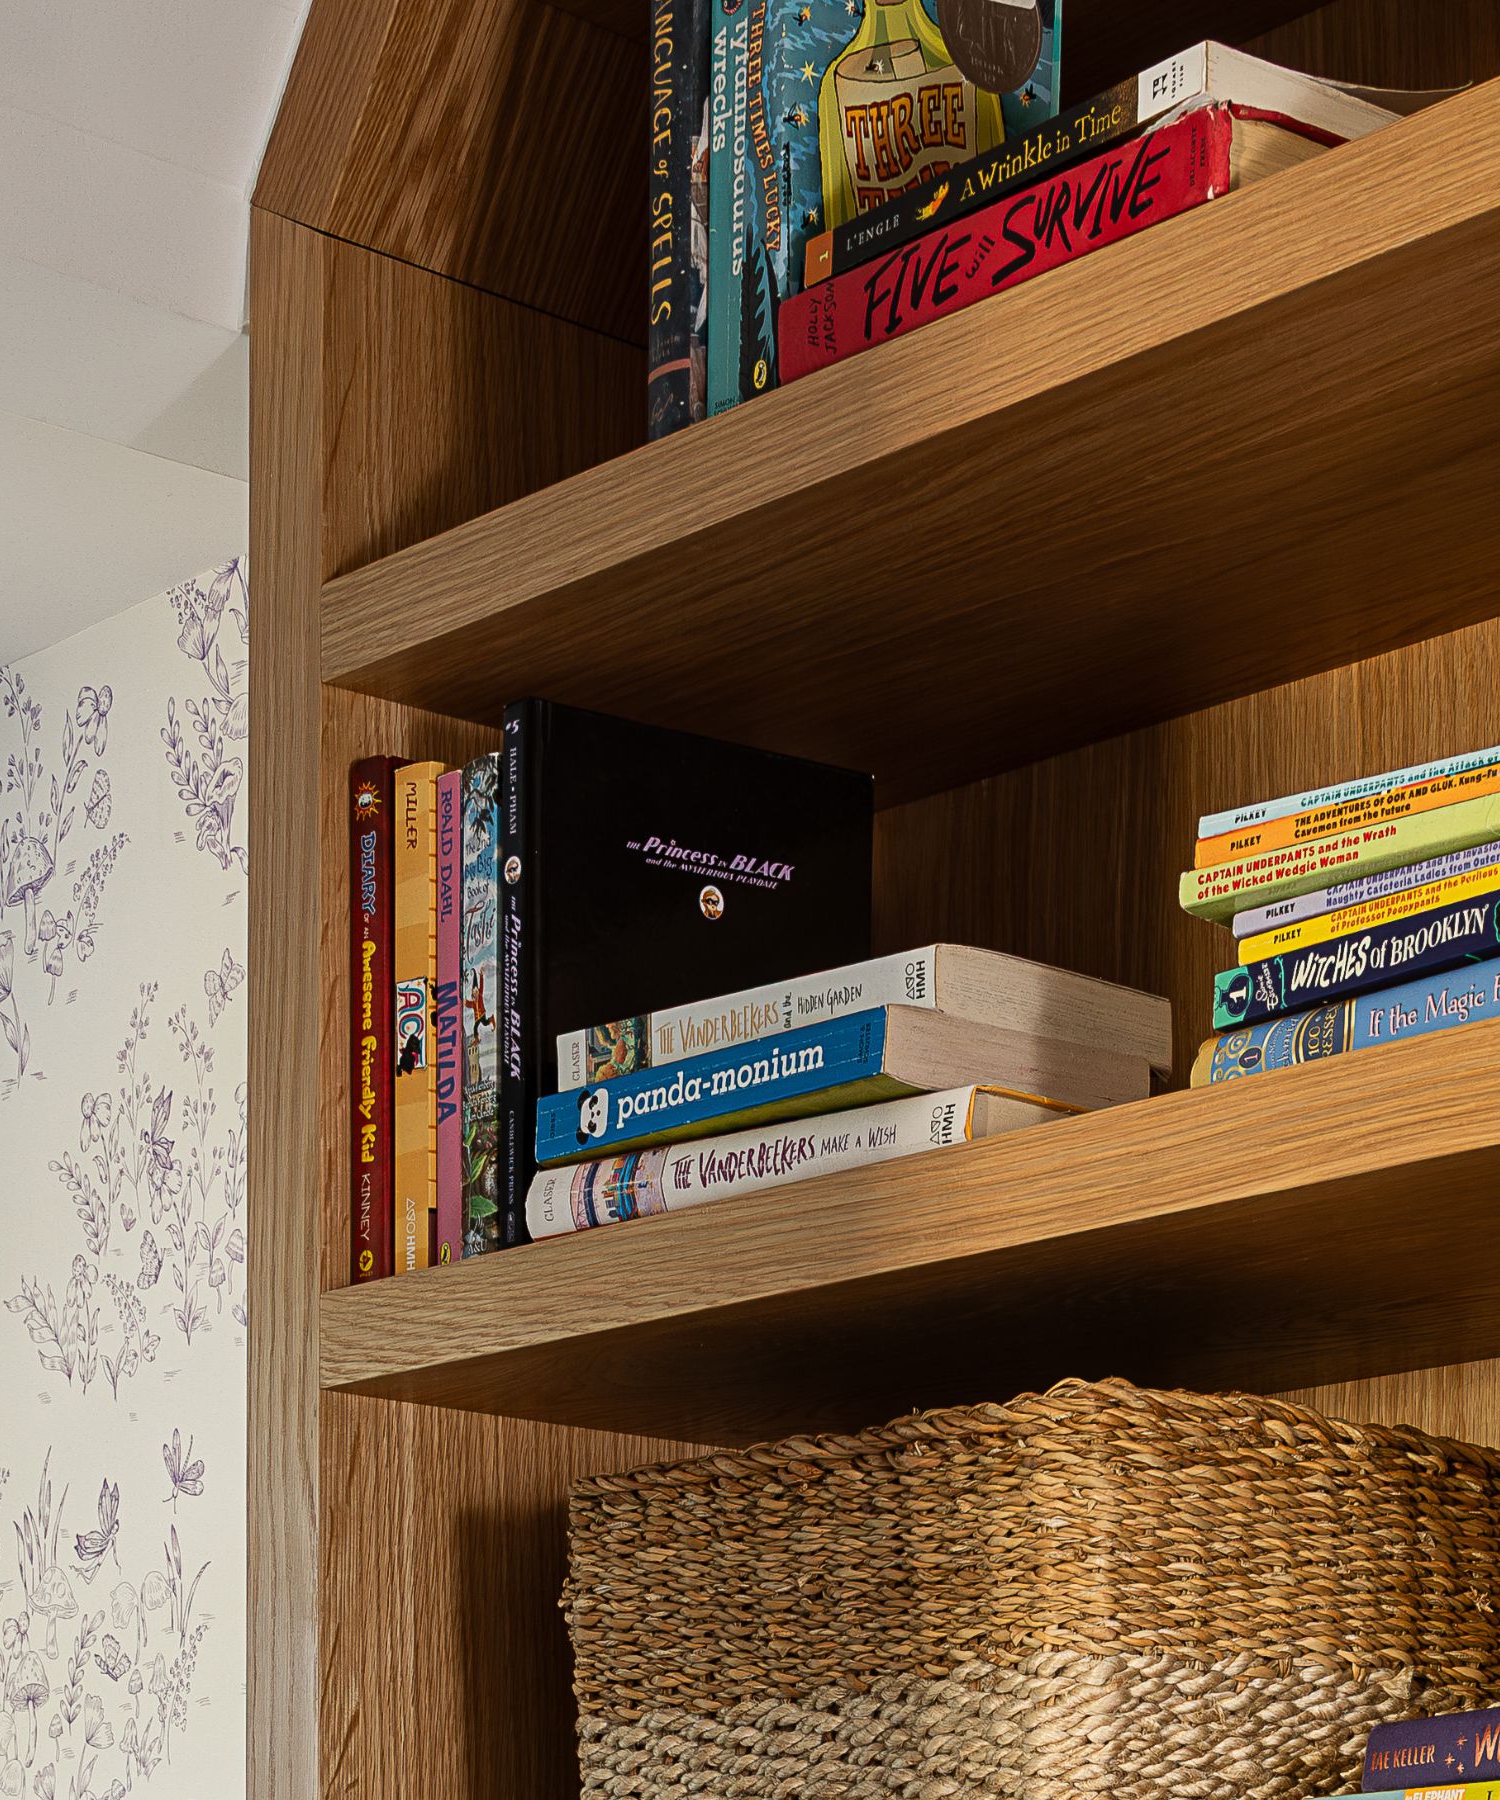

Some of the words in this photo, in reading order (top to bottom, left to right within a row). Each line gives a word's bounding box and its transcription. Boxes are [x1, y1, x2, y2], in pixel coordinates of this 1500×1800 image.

[713, 27, 733, 153] wrecks
[731, 17, 748, 277] tyrannosaurus
[844, 82, 966, 182] THREE
[960, 177, 975, 201] A
[977, 134, 1051, 190] Wrinkle
[1056, 130, 1070, 153] in
[1075, 104, 1122, 142] Time
[651, 192, 673, 325] SPELLS
[864, 233, 972, 342] FIVE
[992, 130, 1171, 284] SURVIVE
[406, 782, 417, 849] MILLER
[441, 788, 452, 856] ROALD
[643, 836, 718, 866] Princess
[729, 854, 795, 881] BLACK
[1197, 864, 1243, 885] CAPTAIN
[1247, 847, 1315, 872] UNDERPANTS
[1318, 840, 1338, 854] and
[1341, 835, 1359, 848] the
[1363, 826, 1397, 842] Wrath
[1197, 889, 1210, 900] of
[1212, 883, 1229, 897] the
[1232, 872, 1273, 891] Wicked
[1276, 863, 1317, 880] Wedgie
[1320, 850, 1359, 866] Woman
[441, 863, 452, 922] DAHL
[1371, 947, 1384, 970] of
[1389, 903, 1490, 967] BROOKLYN
[655, 1021, 676, 1054] THE
[679, 1000, 780, 1053] VANDERBEEKERS
[1368, 1009, 1384, 1037] If
[1389, 1003, 1417, 1033] the
[1424, 986, 1484, 1025] Magic
[436, 982, 459, 1127] MATILDA
[615, 1042, 825, 1129] panda-monium
[670, 1154, 693, 1190] THE
[699, 1133, 815, 1189] VANDERBEEKERS
[820, 1136, 852, 1157] MAKE
[855, 1136, 862, 1149] A
[867, 1125, 897, 1149] WISH
[1392, 1743, 1435, 1768] KELLER
